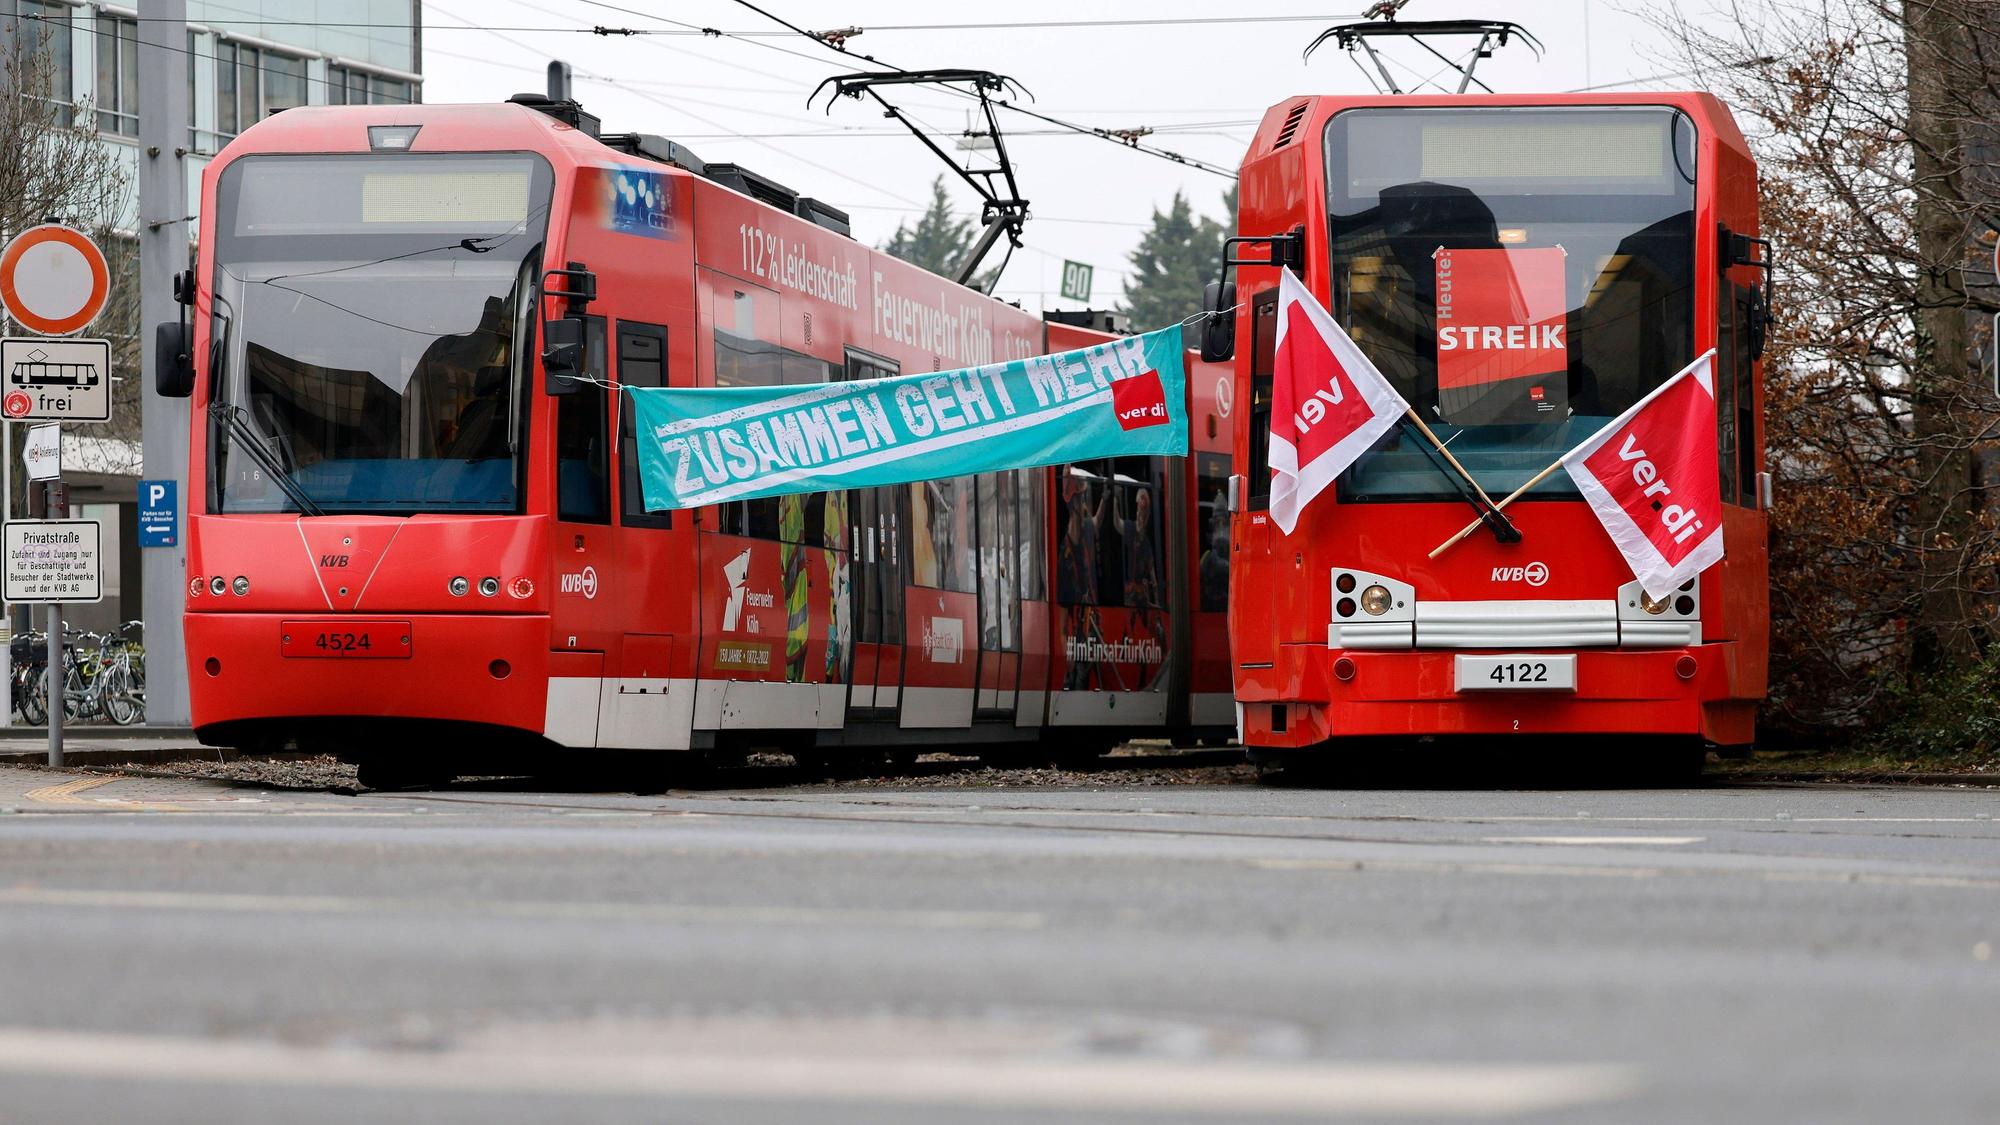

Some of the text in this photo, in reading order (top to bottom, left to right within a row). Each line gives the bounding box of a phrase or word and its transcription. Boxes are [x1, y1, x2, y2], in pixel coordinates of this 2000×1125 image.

[740, 224, 858, 311] 112 % Leidenschaft
[1065, 264, 1090, 298] 90
[1437, 250, 1452, 319] Heute:
[874, 271, 959, 360] Feuerwehr
[960, 304, 993, 366] Köln
[1439, 324, 1565, 350] STREIK
[39, 394, 72, 410] frei
[662, 336, 1152, 496] ZUSAMMEN GEHT MEHR
[150, 485, 165, 507] P
[1618, 433, 1703, 544] ver.di
[23, 532, 80, 543] Privatstraße
[12, 550, 35, 559] Zufahrt
[54, 550, 78, 560] Zugang
[320, 555, 349, 567] KVB
[17, 562, 26, 570] für
[30, 562, 71, 571] Beschäftigte
[1491, 567, 1525, 582] KVB
[10, 573, 39, 581] Besucher
[57, 572, 94, 580] Stadtwerke
[561, 574, 582, 593] KVB
[24, 583, 80, 592] und der KVB AG
[746, 587, 774, 608] Feuerwehr
[746, 614, 760, 634] Köln
[315, 633, 372, 651] 4524
[1066, 636, 1162, 664] #ImEinsatzfürKöln
[1490, 664, 1547, 683] 4122
[1513, 720, 1519, 730] 2
